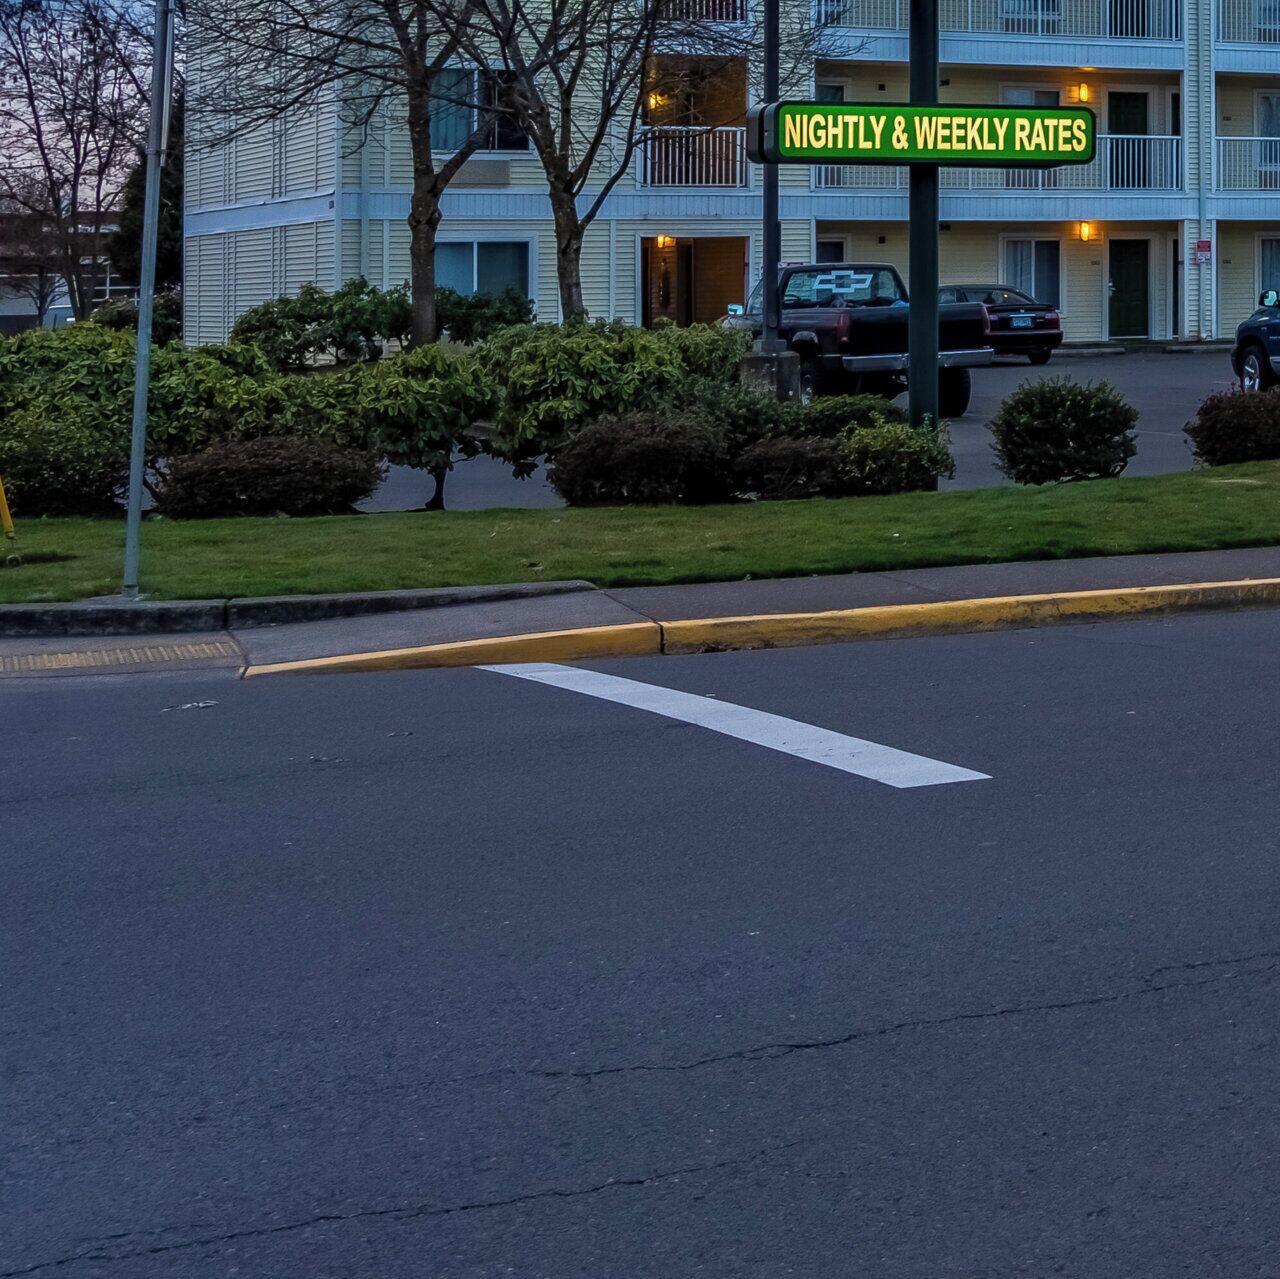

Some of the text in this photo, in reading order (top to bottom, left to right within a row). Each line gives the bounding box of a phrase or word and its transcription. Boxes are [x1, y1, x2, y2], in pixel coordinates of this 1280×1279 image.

[785, 114, 1087, 152] NIGHTLY & WEEKLY RATES
